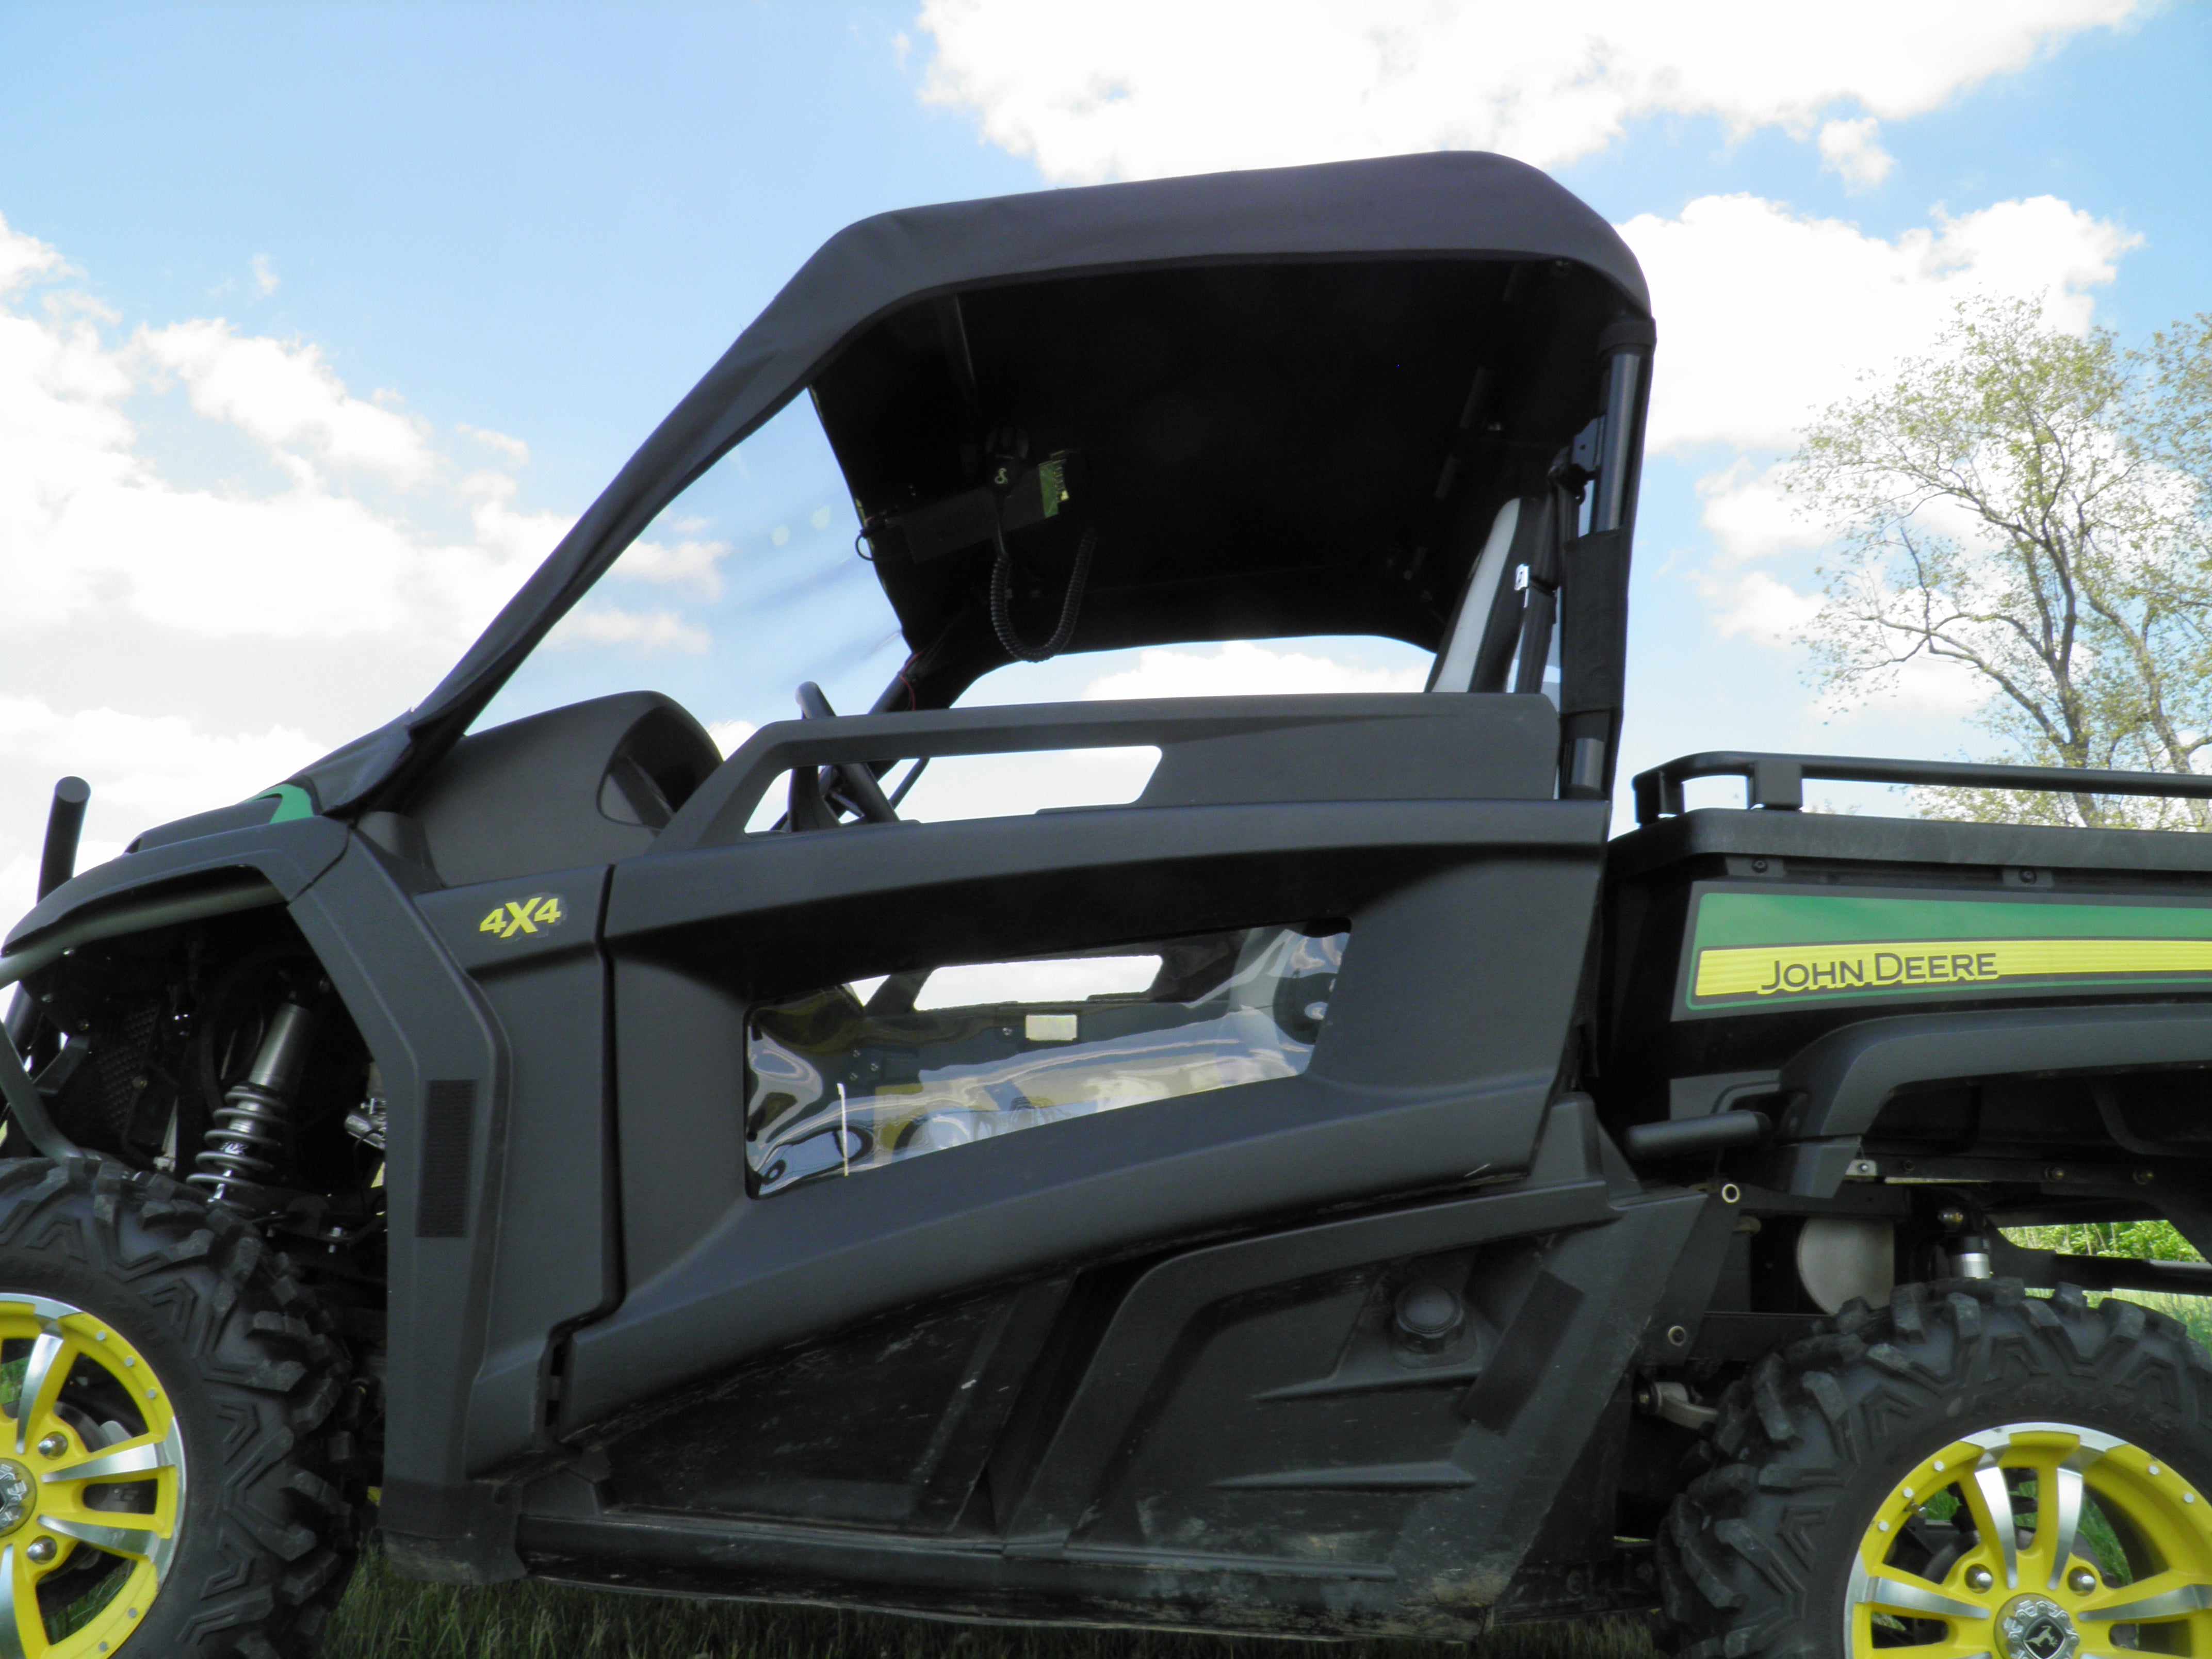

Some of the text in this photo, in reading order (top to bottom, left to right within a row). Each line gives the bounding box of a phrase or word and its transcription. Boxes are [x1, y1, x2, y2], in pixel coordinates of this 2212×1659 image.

[479, 897, 562, 938] 4X4
[1761, 952, 1998, 991] JOHN DEERE
